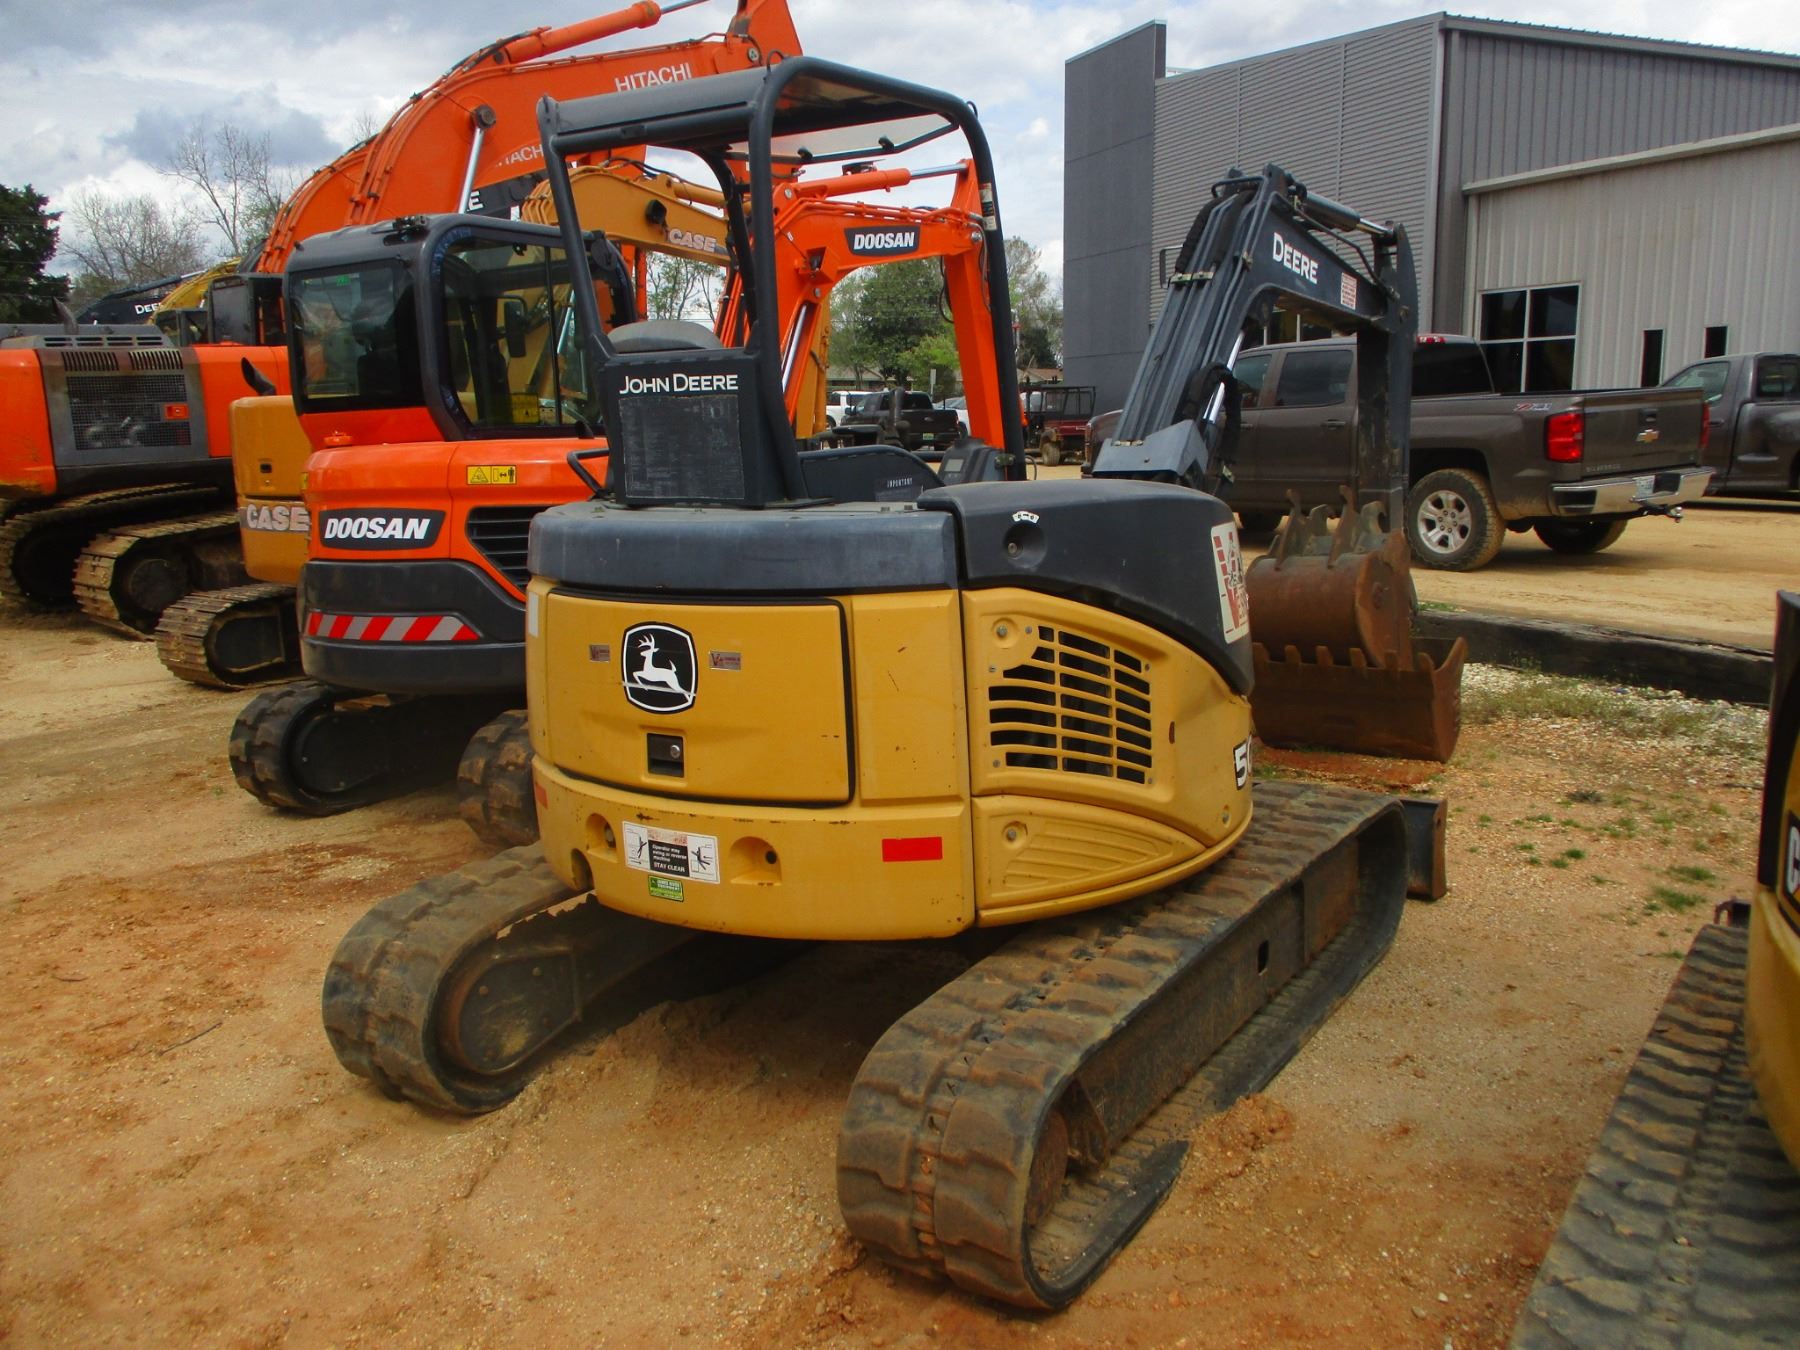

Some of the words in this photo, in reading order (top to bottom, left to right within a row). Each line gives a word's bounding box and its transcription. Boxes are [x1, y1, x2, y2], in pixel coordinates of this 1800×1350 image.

[615, 62, 692, 92] HITACHI
[669, 228, 717, 253] CASE
[853, 232, 915, 250] DOOSAN
[1273, 232, 1318, 285] DEERE
[134, 302, 162, 315] DEE
[619, 376, 670, 395] JOHN
[673, 373, 739, 392] DEERE
[246, 504, 311, 532] CASE
[324, 518, 431, 540] DOOSAN
[653, 862, 667, 870] STAY
[667, 864, 685, 872] CLEAR
